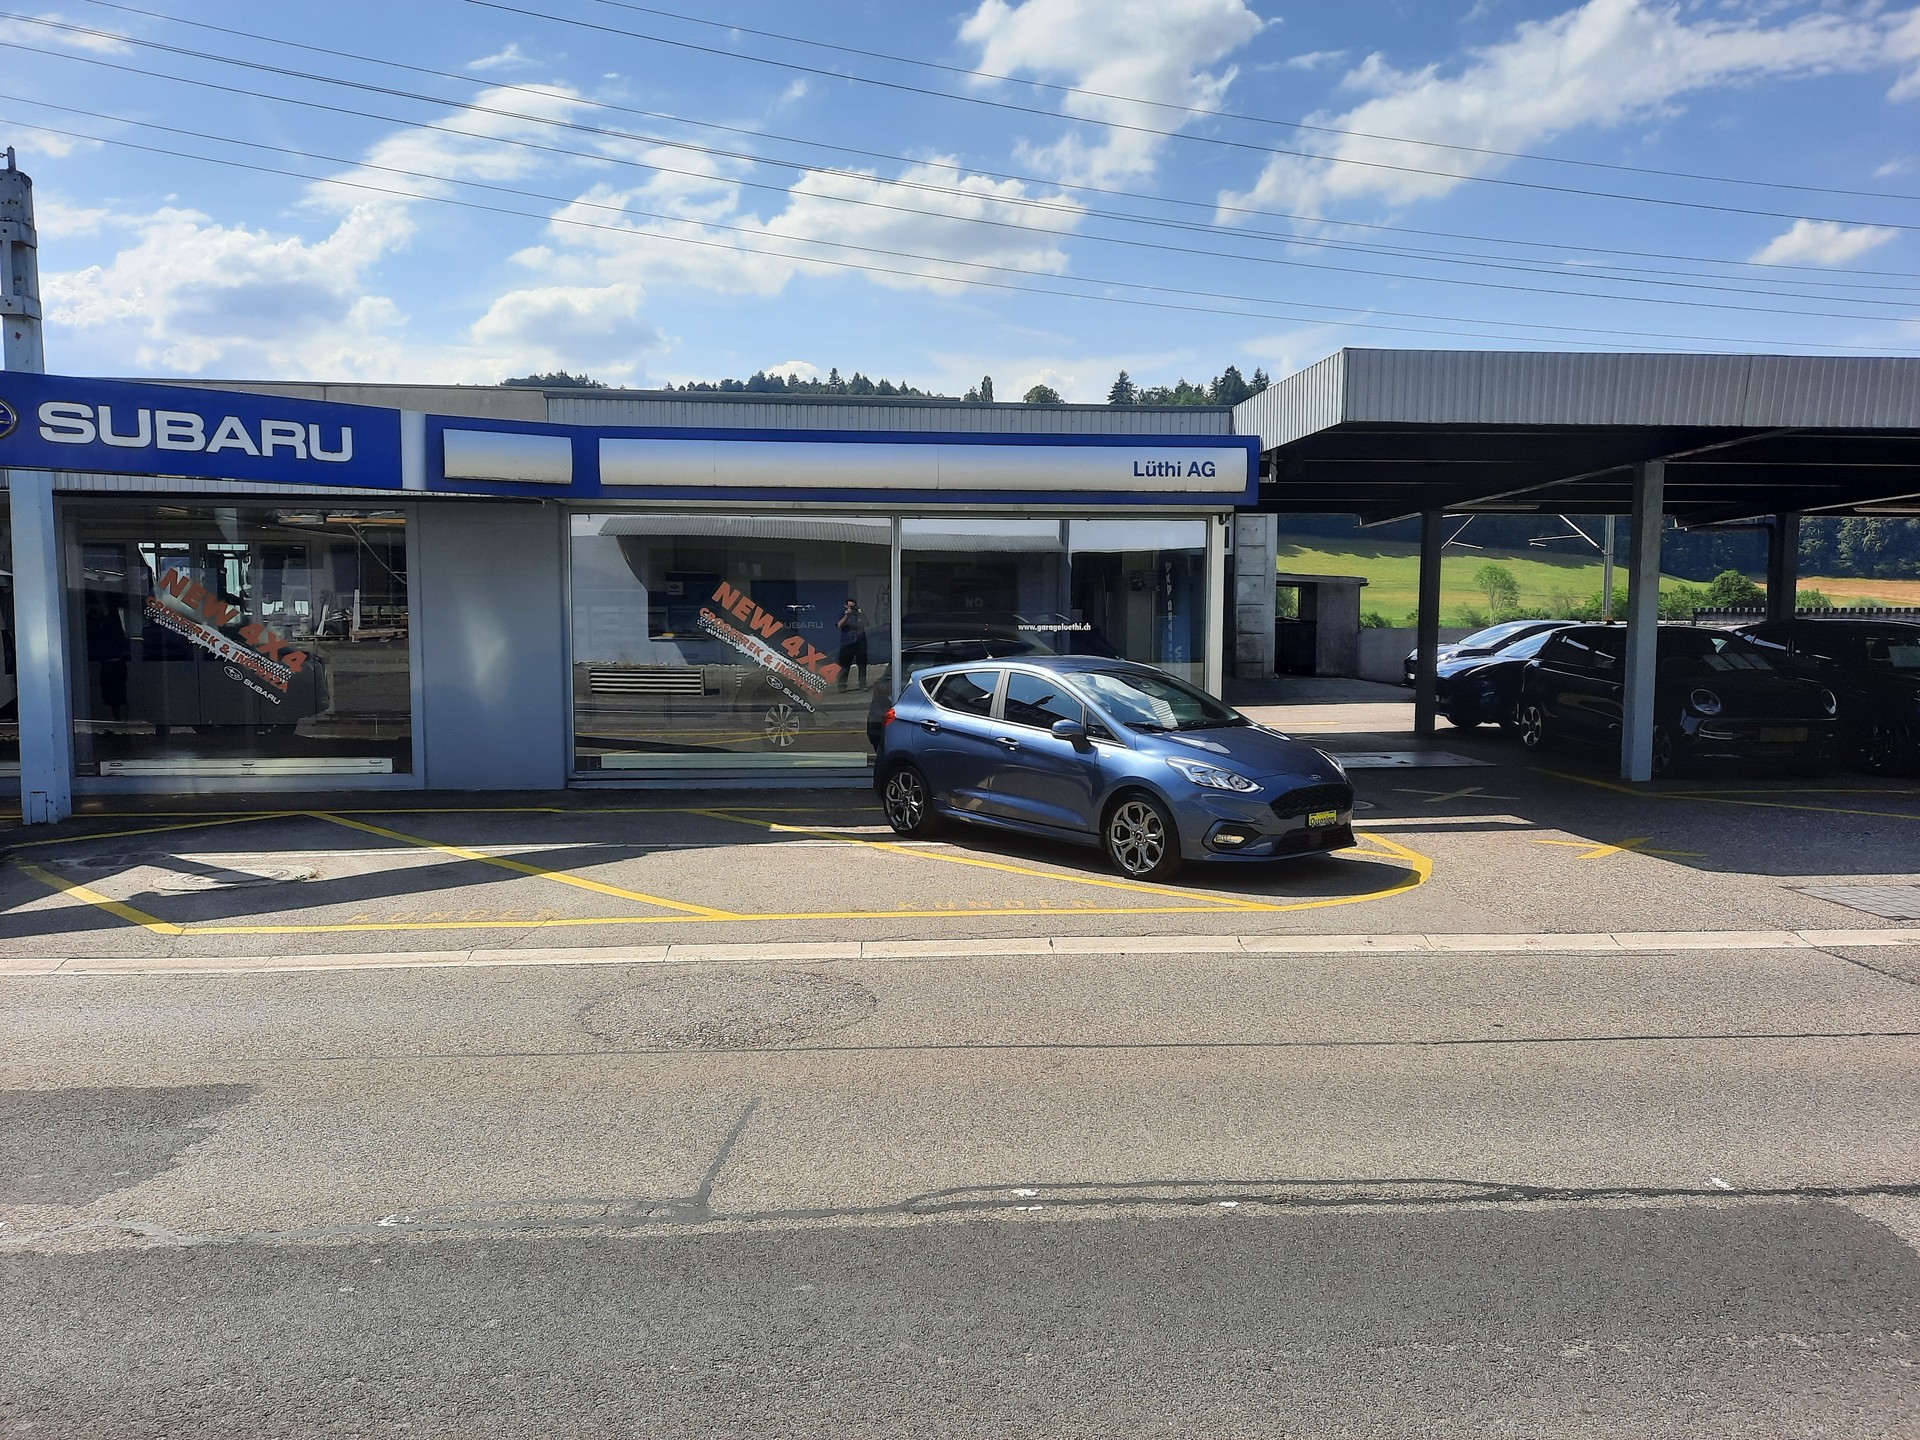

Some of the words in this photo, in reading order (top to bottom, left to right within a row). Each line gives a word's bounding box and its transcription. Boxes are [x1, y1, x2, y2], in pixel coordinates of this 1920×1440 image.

[38, 401, 353, 462] SUBARU
[1133, 460, 1181, 478] Lüthi
[1187, 460, 1216, 478] AG
[159, 567, 240, 627] NEW
[238, 623, 308, 673] 4X4
[783, 620, 824, 630] UBARU
[1017, 622, 1092, 633] www.garageluethi.ch
[711, 581, 784, 639] NEW
[781, 635, 842, 685] 4X4
[219, 643, 231, 656] &
[762, 654, 774, 666] &
[243, 678, 282, 706] SUBARU
[783, 687, 816, 714] SUBARU
